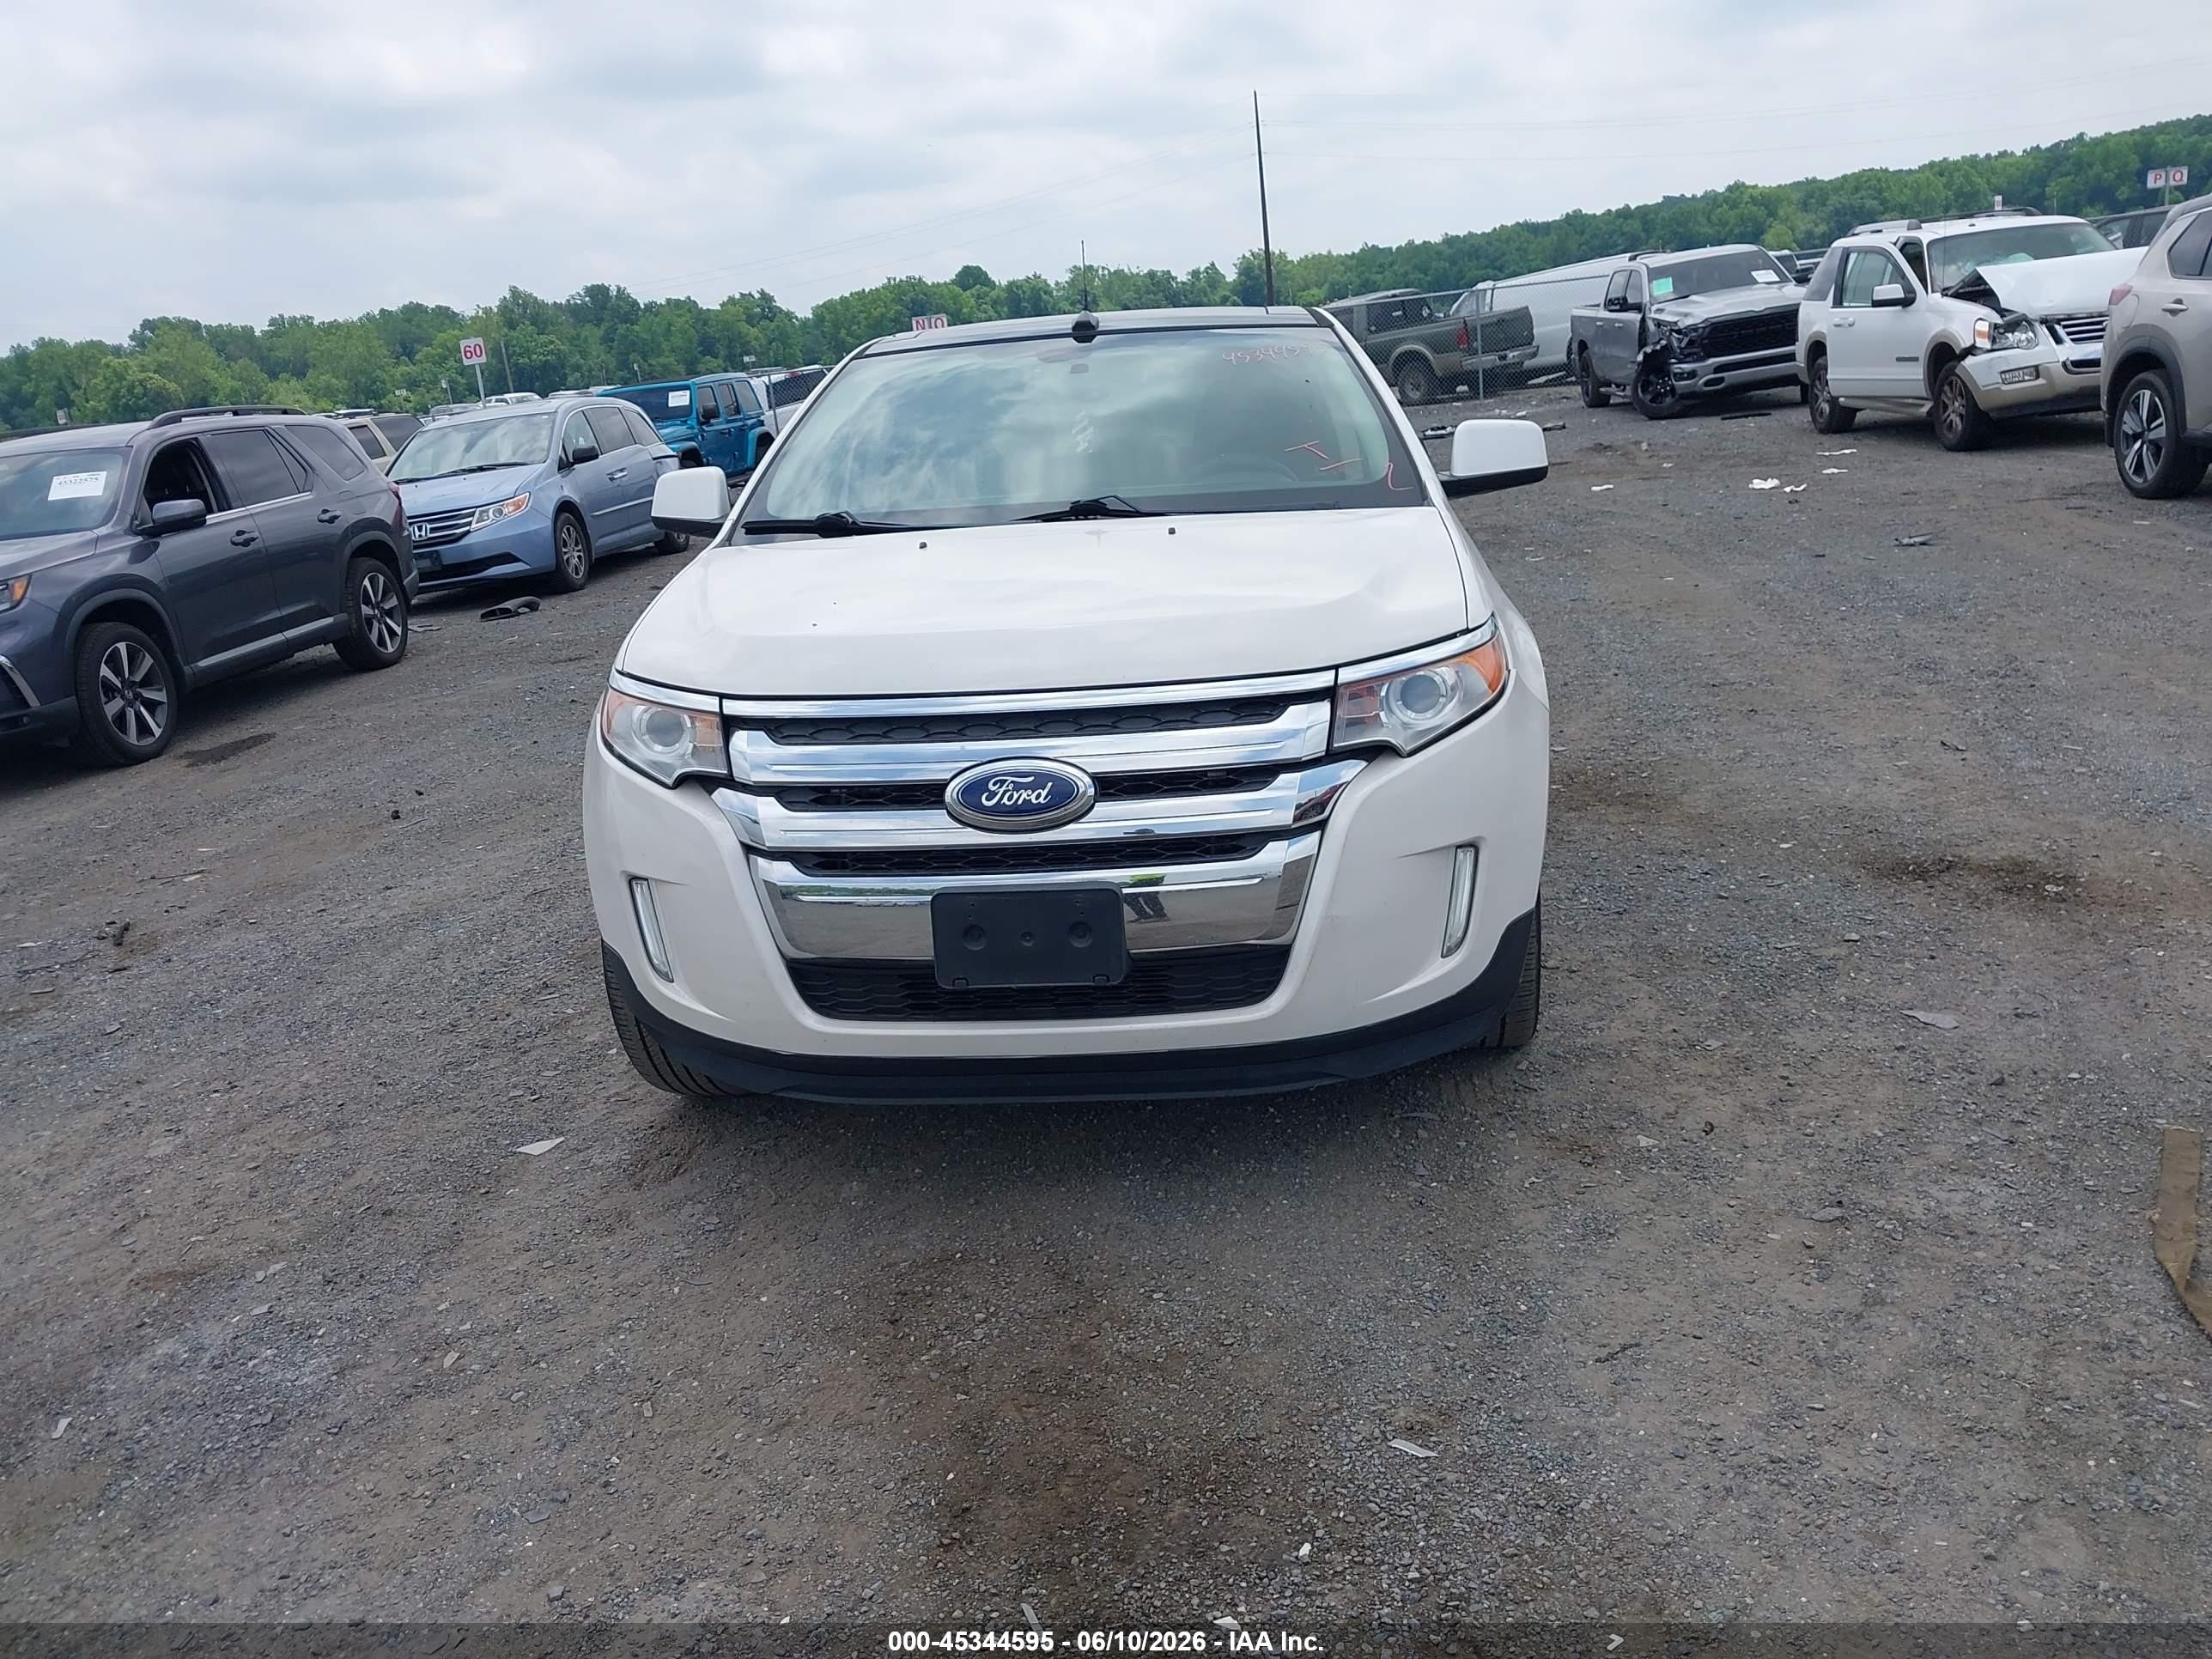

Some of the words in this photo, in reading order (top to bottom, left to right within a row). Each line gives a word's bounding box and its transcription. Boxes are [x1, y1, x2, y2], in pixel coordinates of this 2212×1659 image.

[2154, 173, 2163, 185] P
[2172, 170, 2185, 183] Q
[915, 318, 926, 331] N
[463, 343, 483, 360] 60
[981, 776, 1054, 806] Ford
